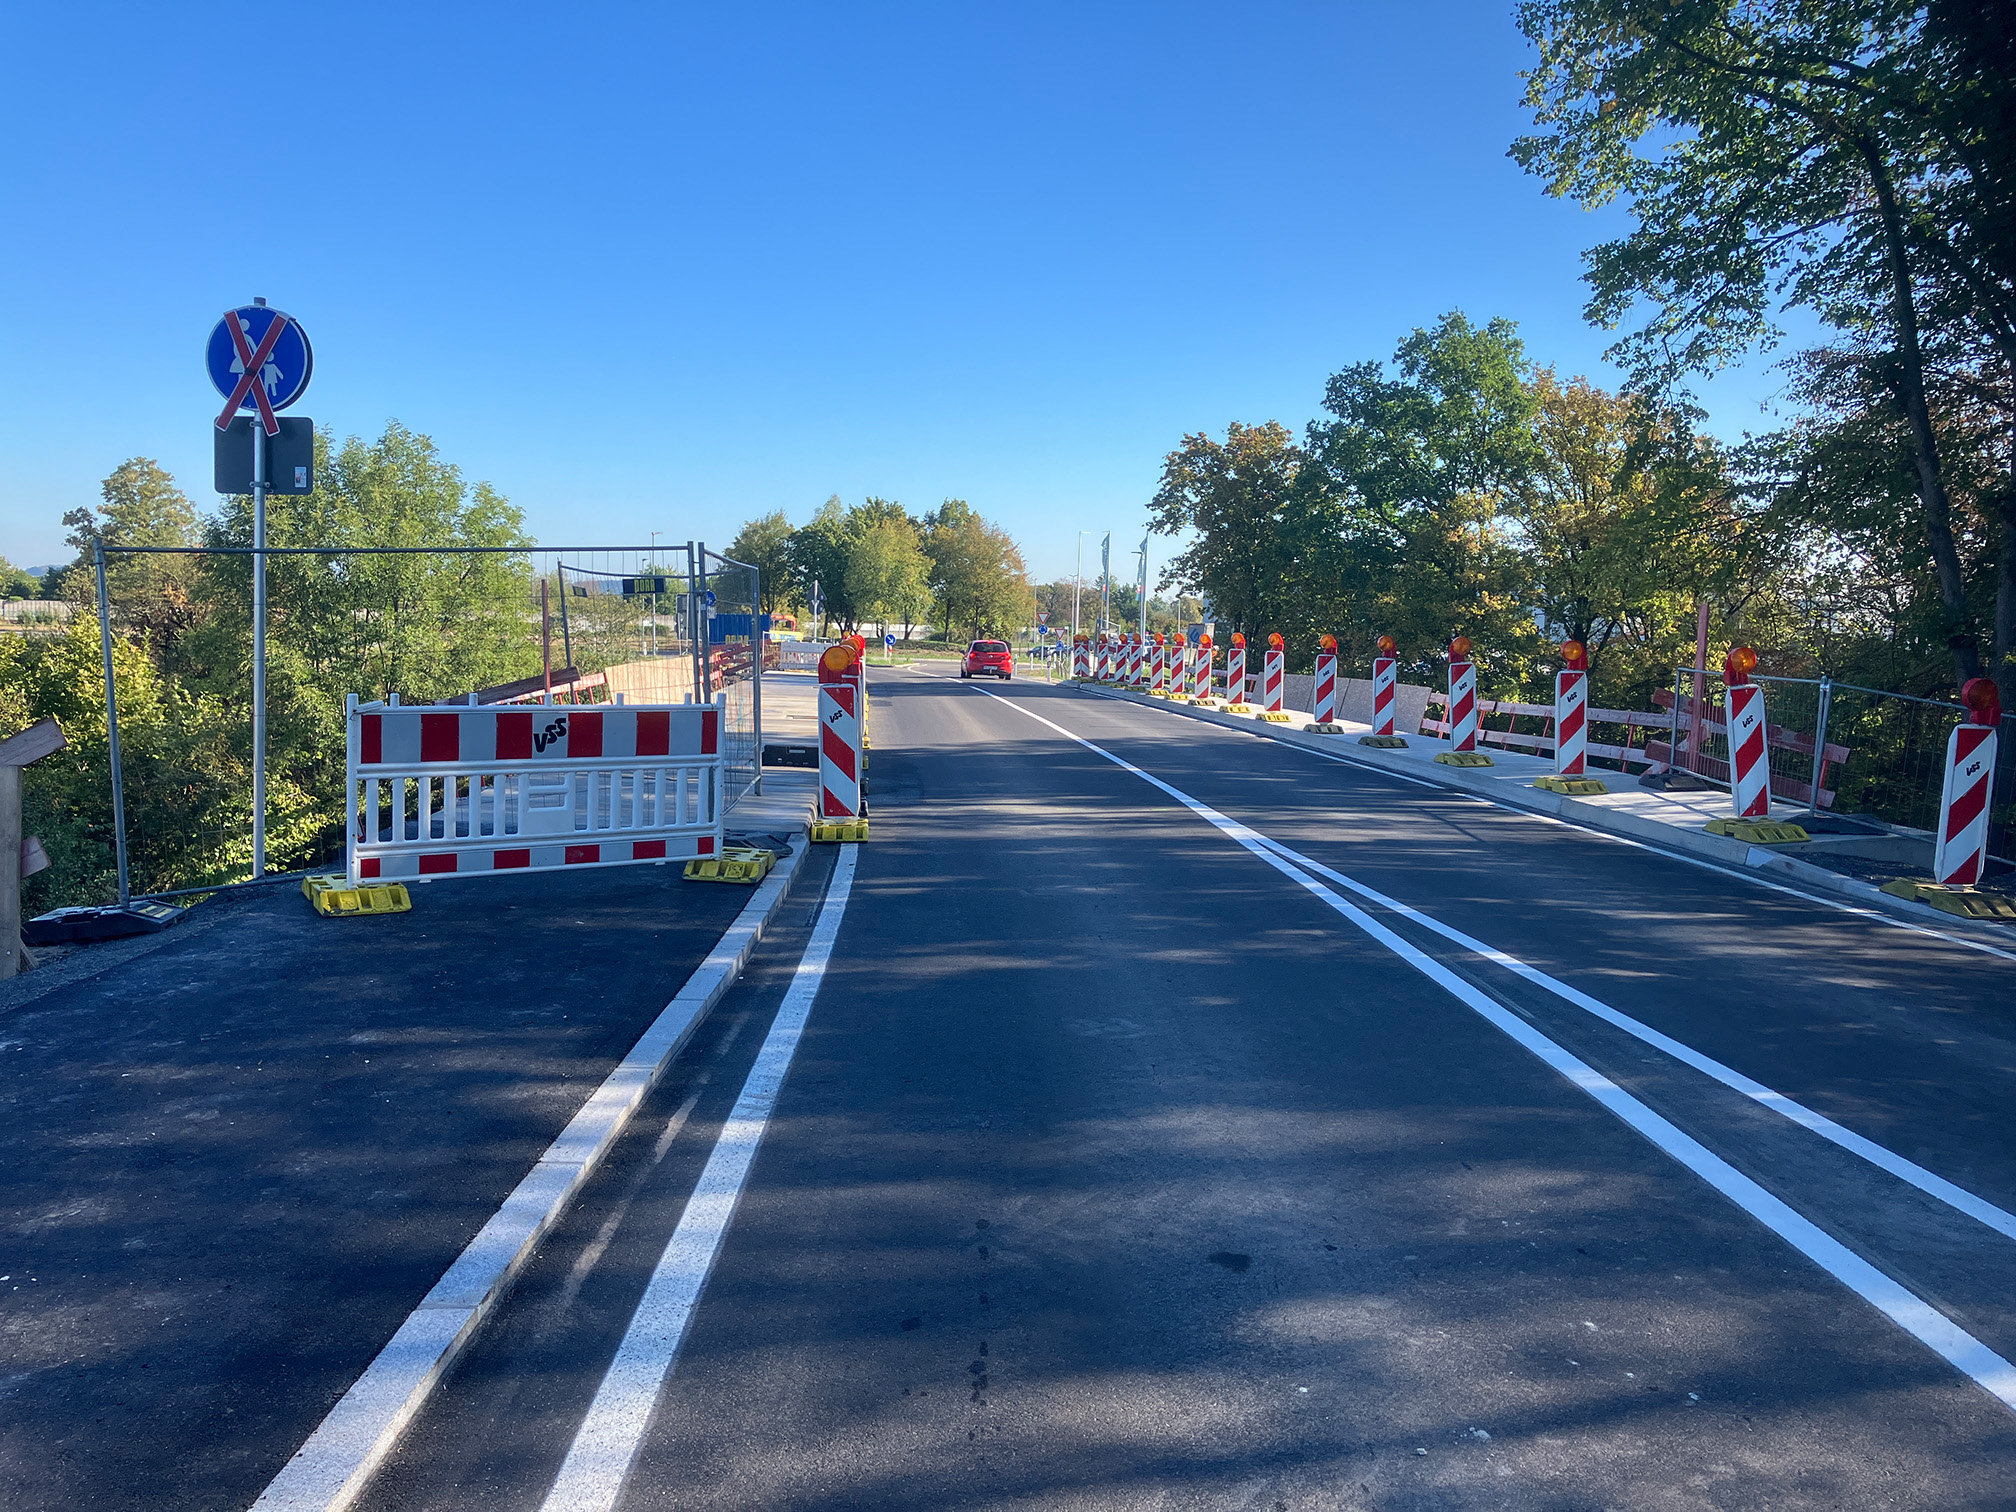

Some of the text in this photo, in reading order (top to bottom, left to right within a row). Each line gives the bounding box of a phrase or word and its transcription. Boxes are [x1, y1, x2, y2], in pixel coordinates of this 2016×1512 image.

[1567, 691, 1577, 703] VSS
[829, 710, 843, 723] VSS
[1742, 715, 1754, 728] VSS
[533, 717, 567, 753] VSS
[1966, 761, 1981, 776] VSS
